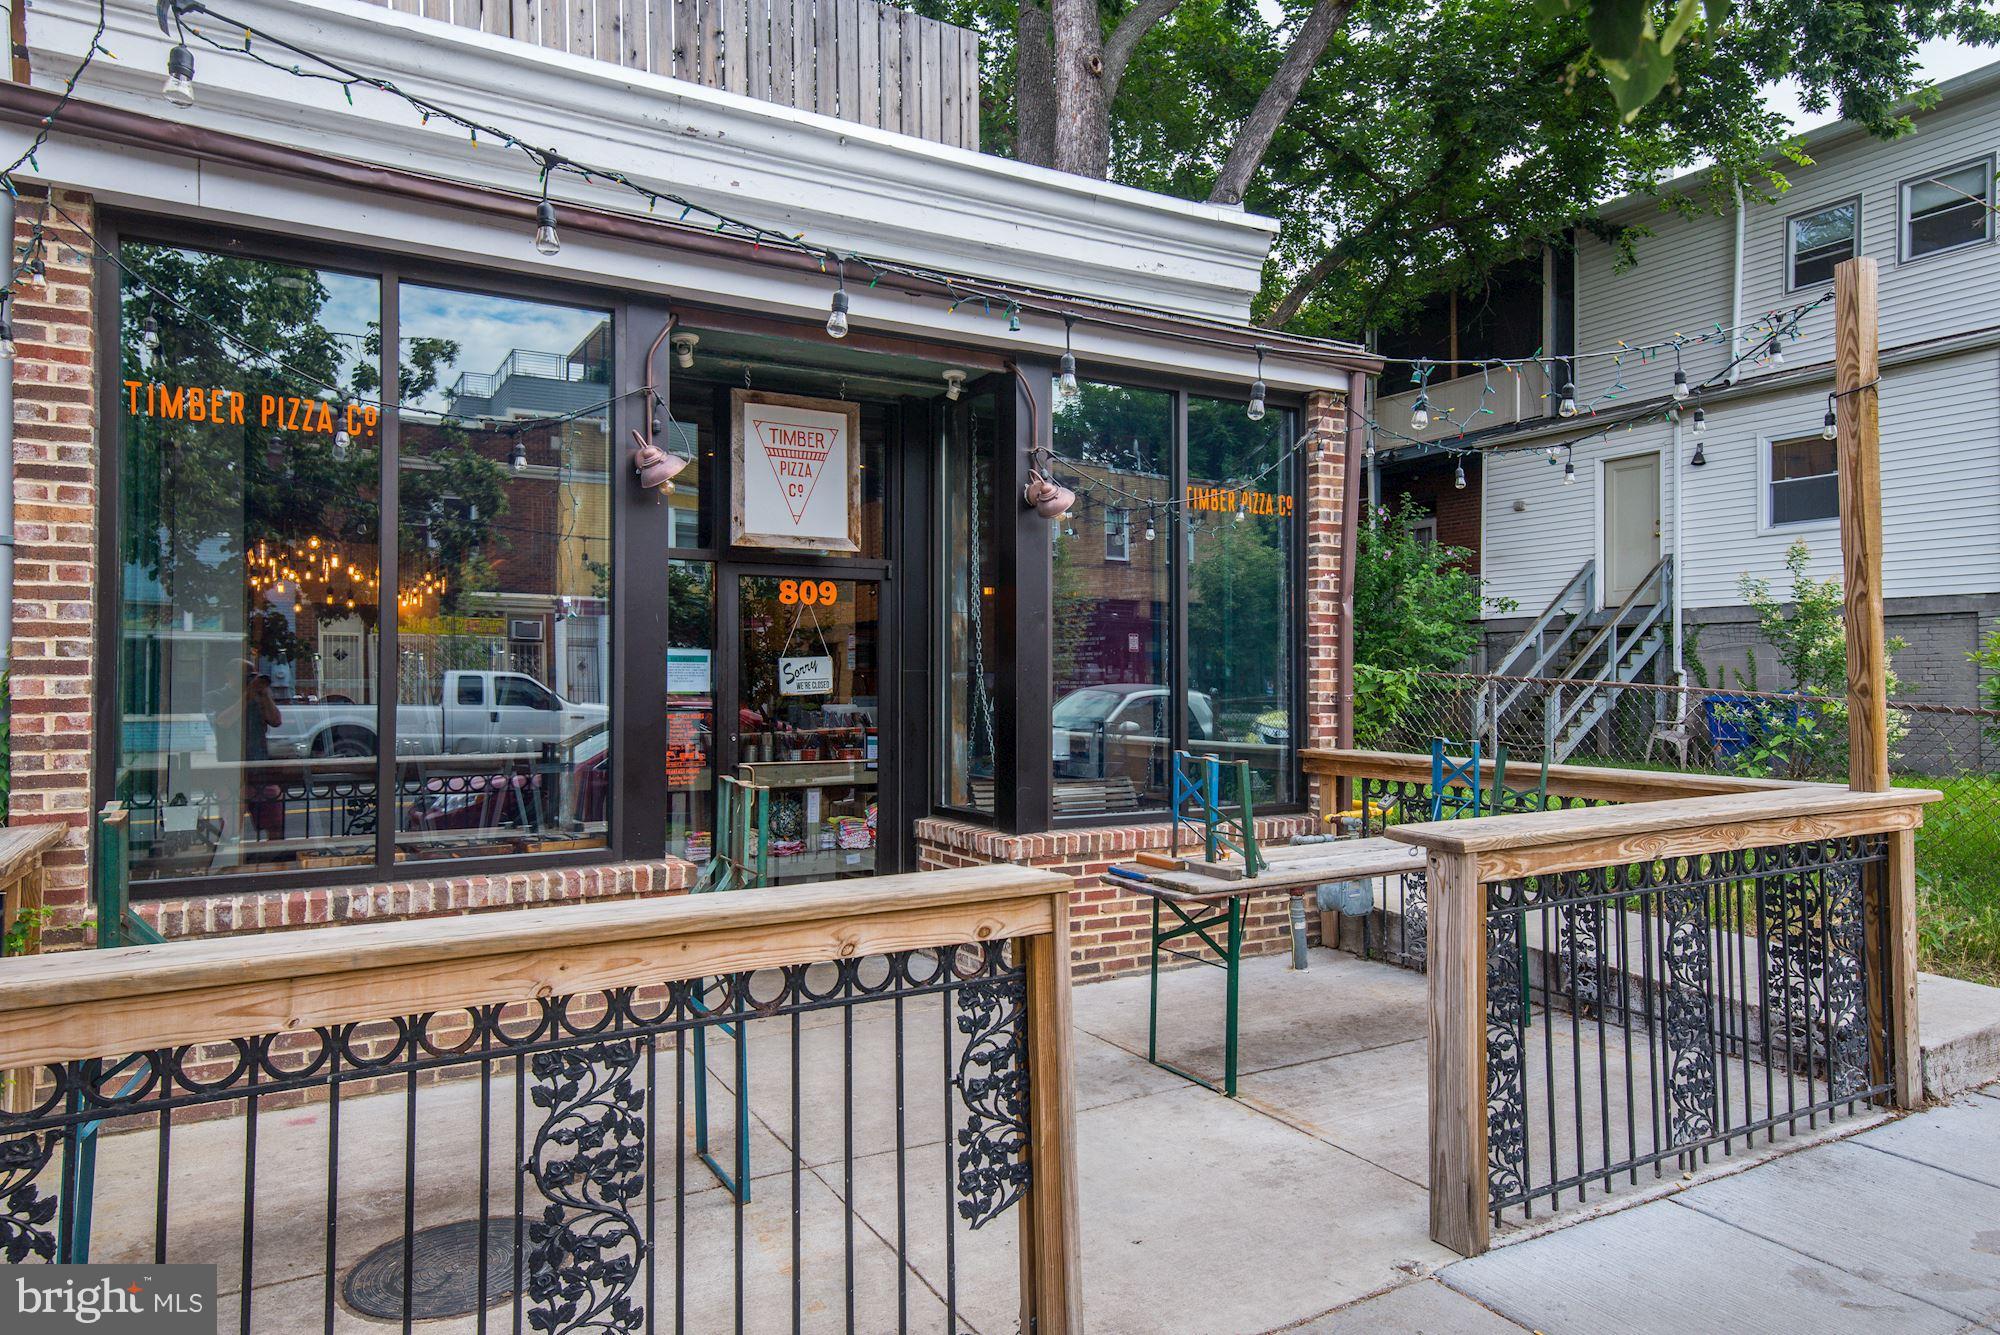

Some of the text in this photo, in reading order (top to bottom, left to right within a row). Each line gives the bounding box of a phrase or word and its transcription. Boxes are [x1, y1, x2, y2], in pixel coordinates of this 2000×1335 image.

[124, 380, 245, 425] TIMBER
[261, 394, 333, 434] PIZZA
[769, 427, 825, 449] TIMBER
[780, 460, 812, 478] PIZZA
[1186, 486, 1236, 513] TIMBER
[1241, 490, 1274, 515] PIZZA
[778, 579, 838, 606] 809
[783, 660, 818, 685] Sorry
[796, 680, 830, 690] WE'RE CLOSED
